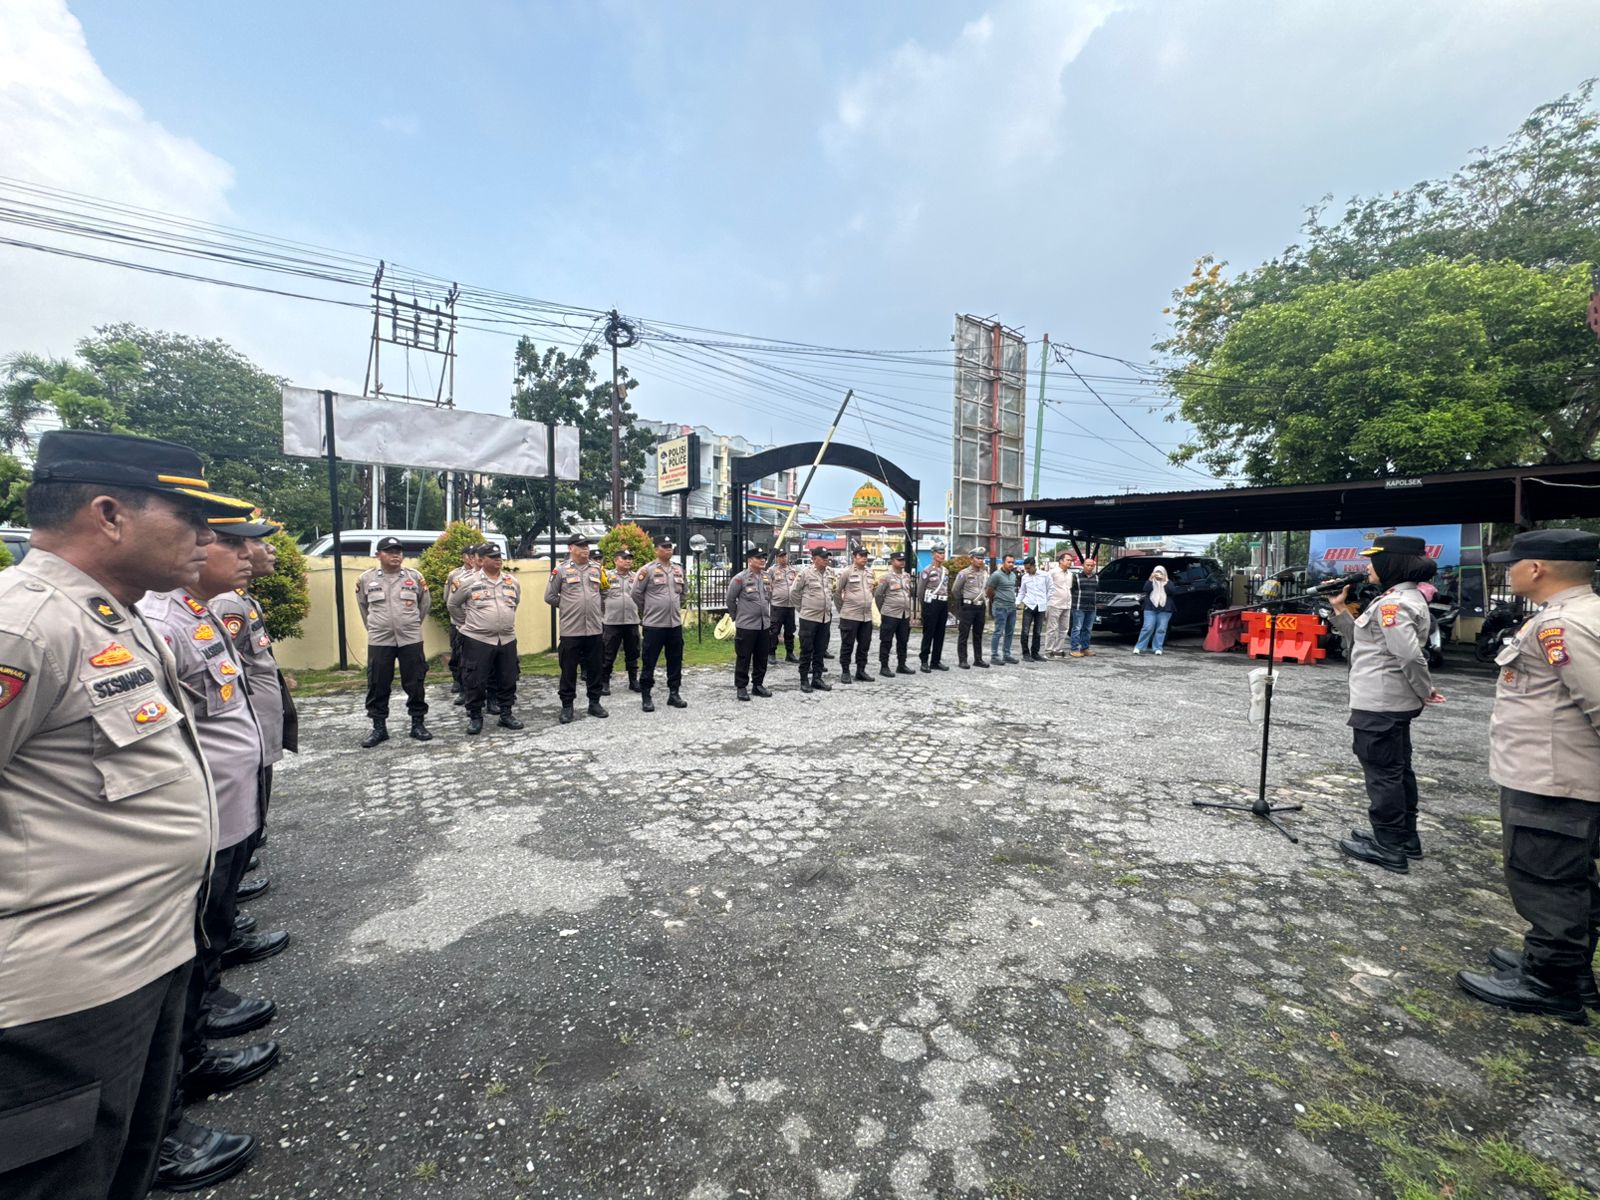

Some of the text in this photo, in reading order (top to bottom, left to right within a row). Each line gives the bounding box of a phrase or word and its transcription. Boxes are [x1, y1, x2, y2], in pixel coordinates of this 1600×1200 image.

[669, 445, 686, 457] POLISI
[669, 455, 686, 467] POLICE
[1386, 478, 1422, 487] KAPOLSEK
